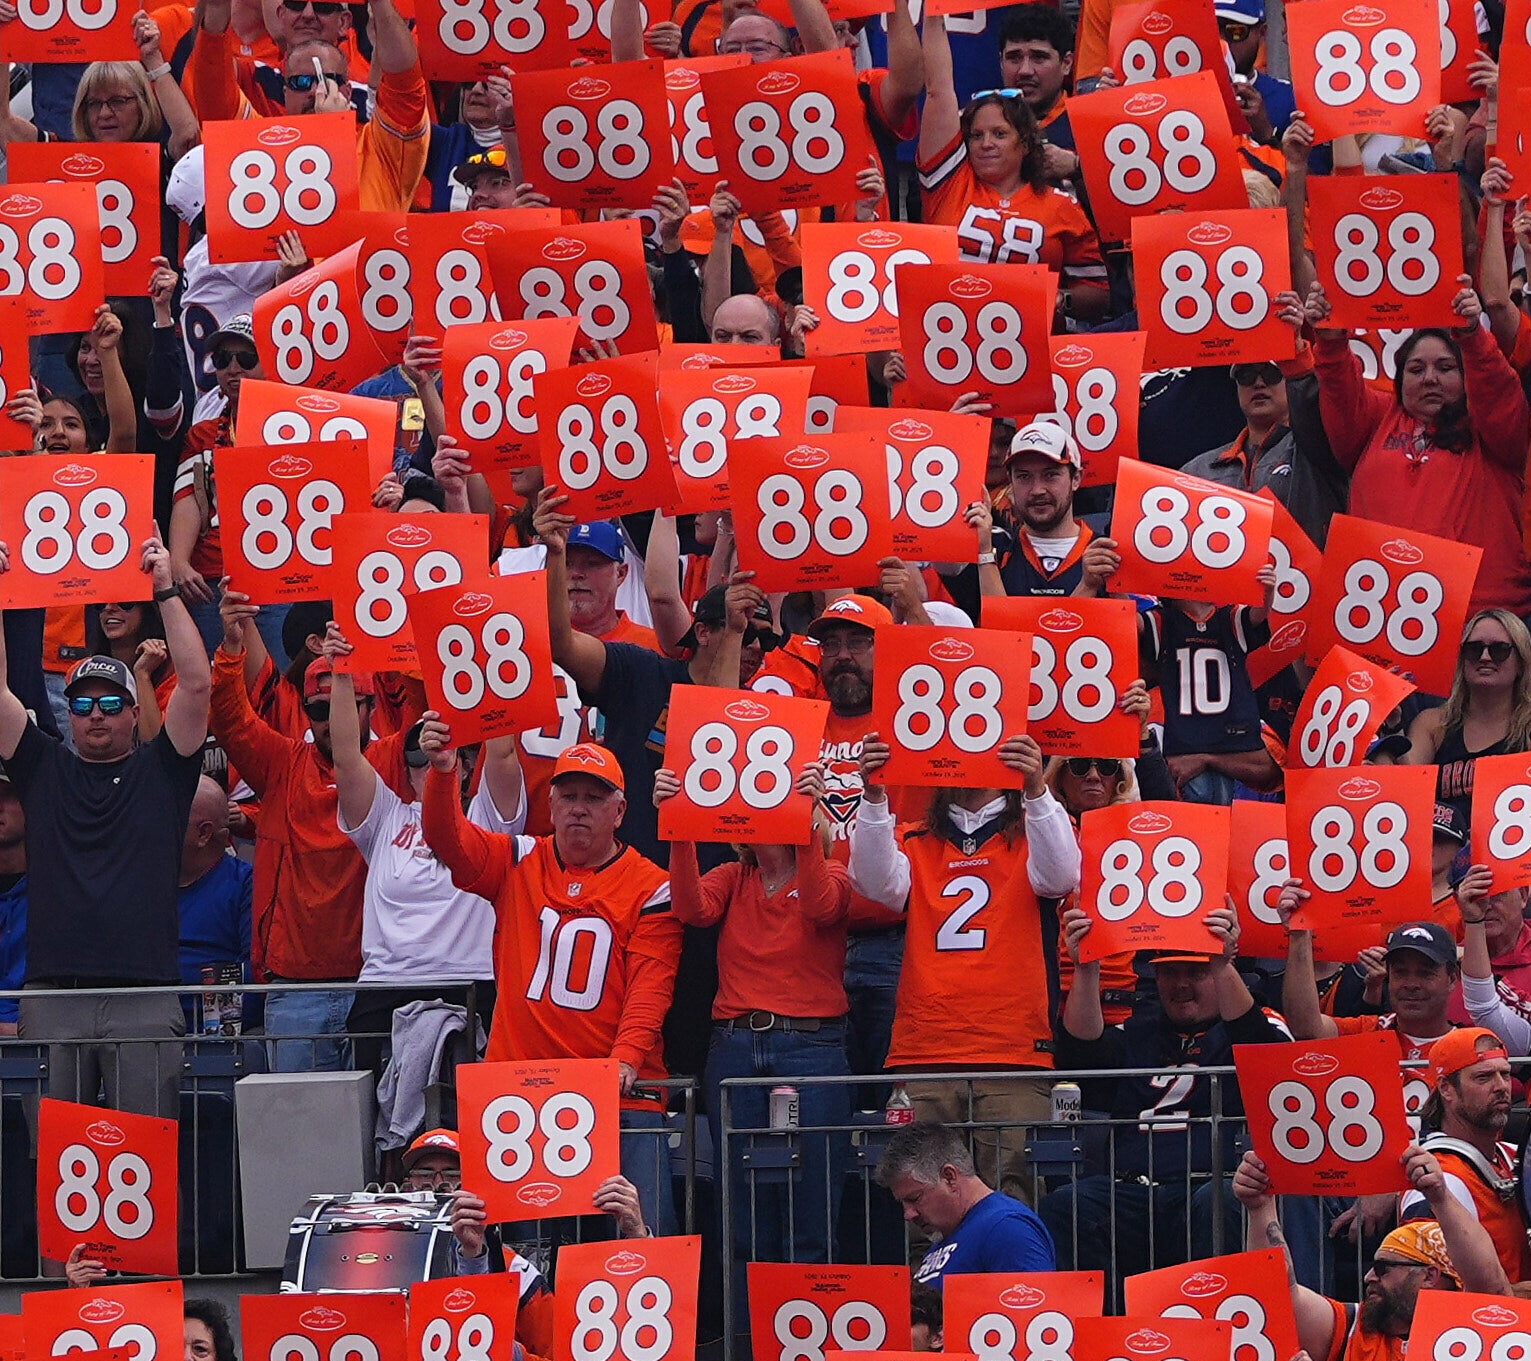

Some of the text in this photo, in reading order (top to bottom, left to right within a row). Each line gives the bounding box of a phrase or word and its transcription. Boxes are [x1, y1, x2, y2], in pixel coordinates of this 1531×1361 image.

[734, 92, 844, 181] 88
[957, 203, 1045, 265] 58
[1334, 559, 1443, 656] 88
[76, 659, 118, 677] Circa
[437, 613, 531, 710] 88
[1177, 648, 1232, 714] 10
[948, 858, 990, 869] BRONCOS
[935, 876, 990, 951] 2
[526, 905, 613, 1011] 10
